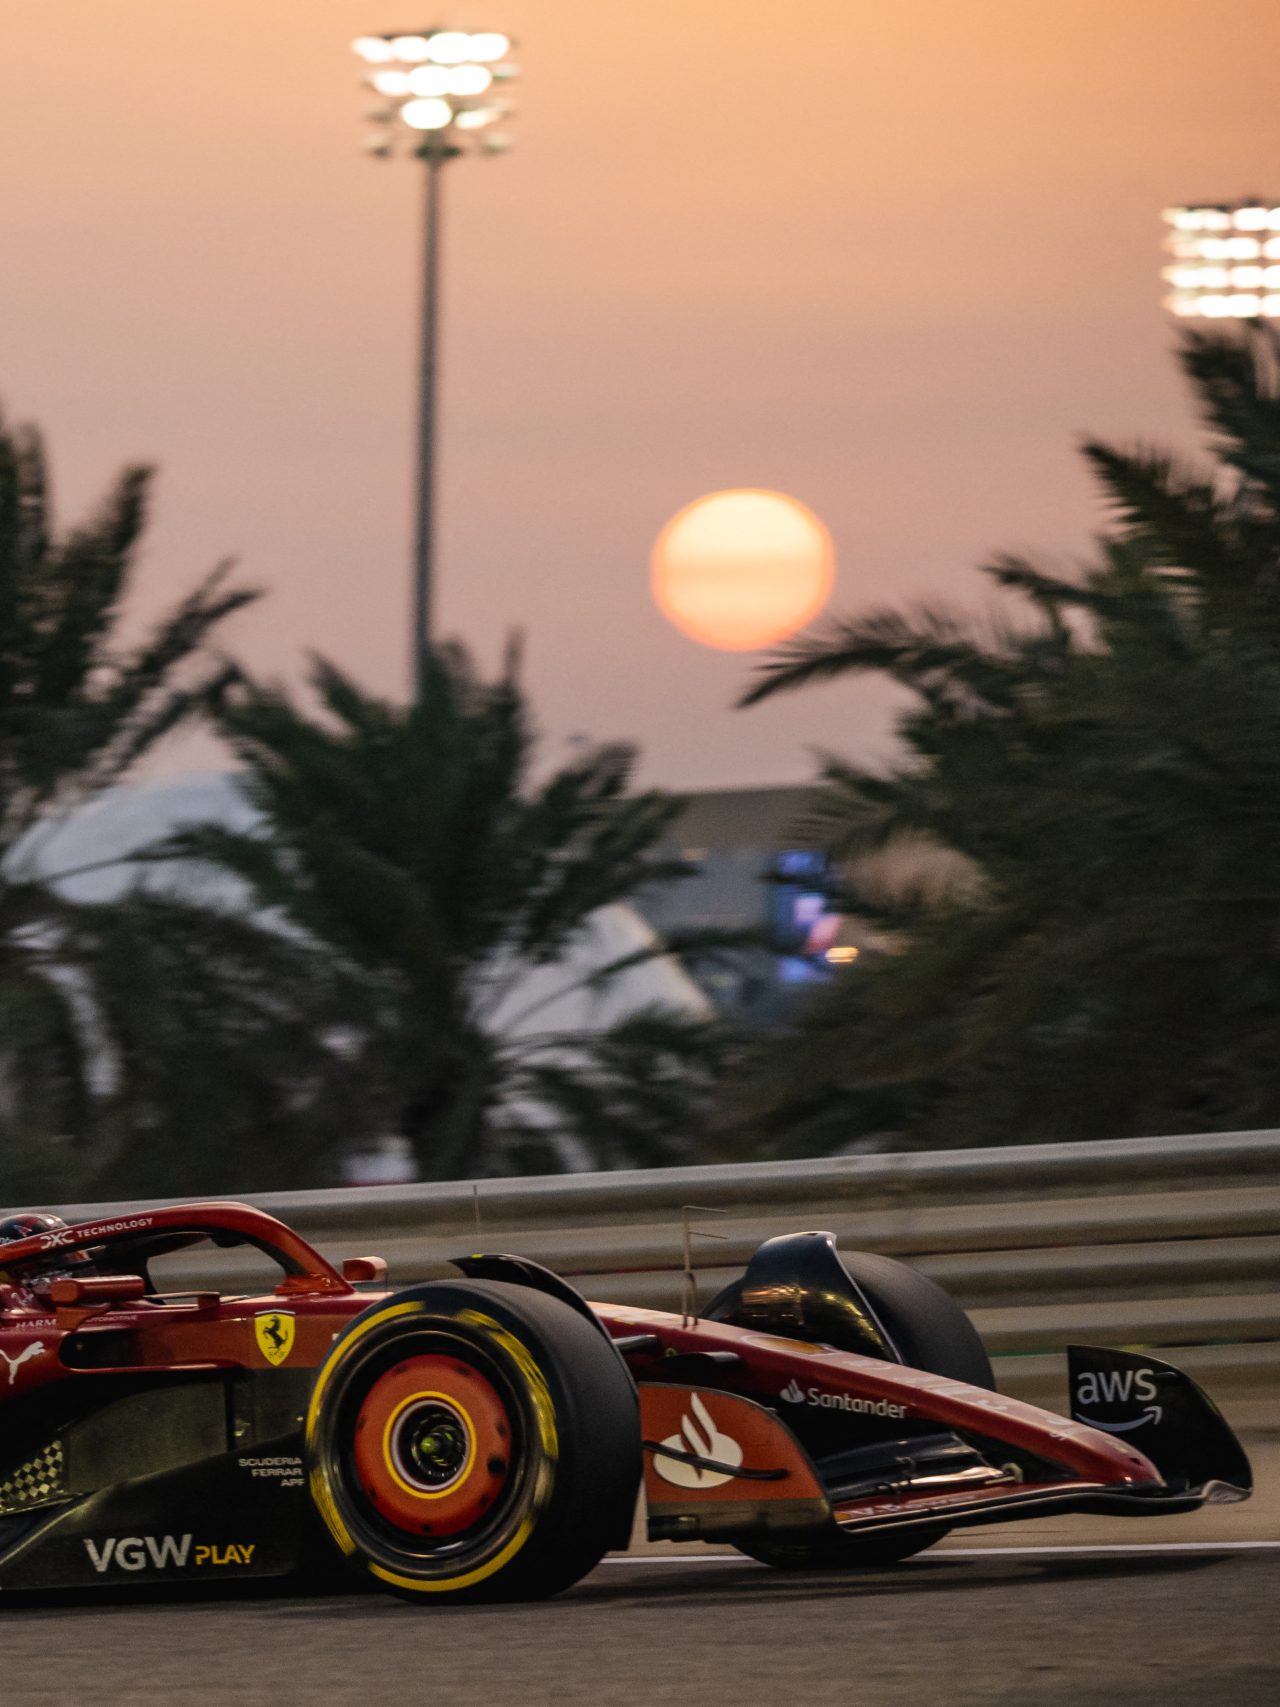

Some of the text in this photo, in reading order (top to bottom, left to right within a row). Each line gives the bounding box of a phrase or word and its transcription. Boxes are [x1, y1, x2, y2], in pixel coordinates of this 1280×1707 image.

[76, 1217, 153, 1238] TECHNOLOGY
[1077, 1368, 1158, 1404] aws
[808, 1387, 908, 1420] Santander
[238, 1457, 302, 1467] SCUDERIA
[251, 1468, 303, 1477] FERRAR
[83, 1534, 256, 1573] VGW PLAY
